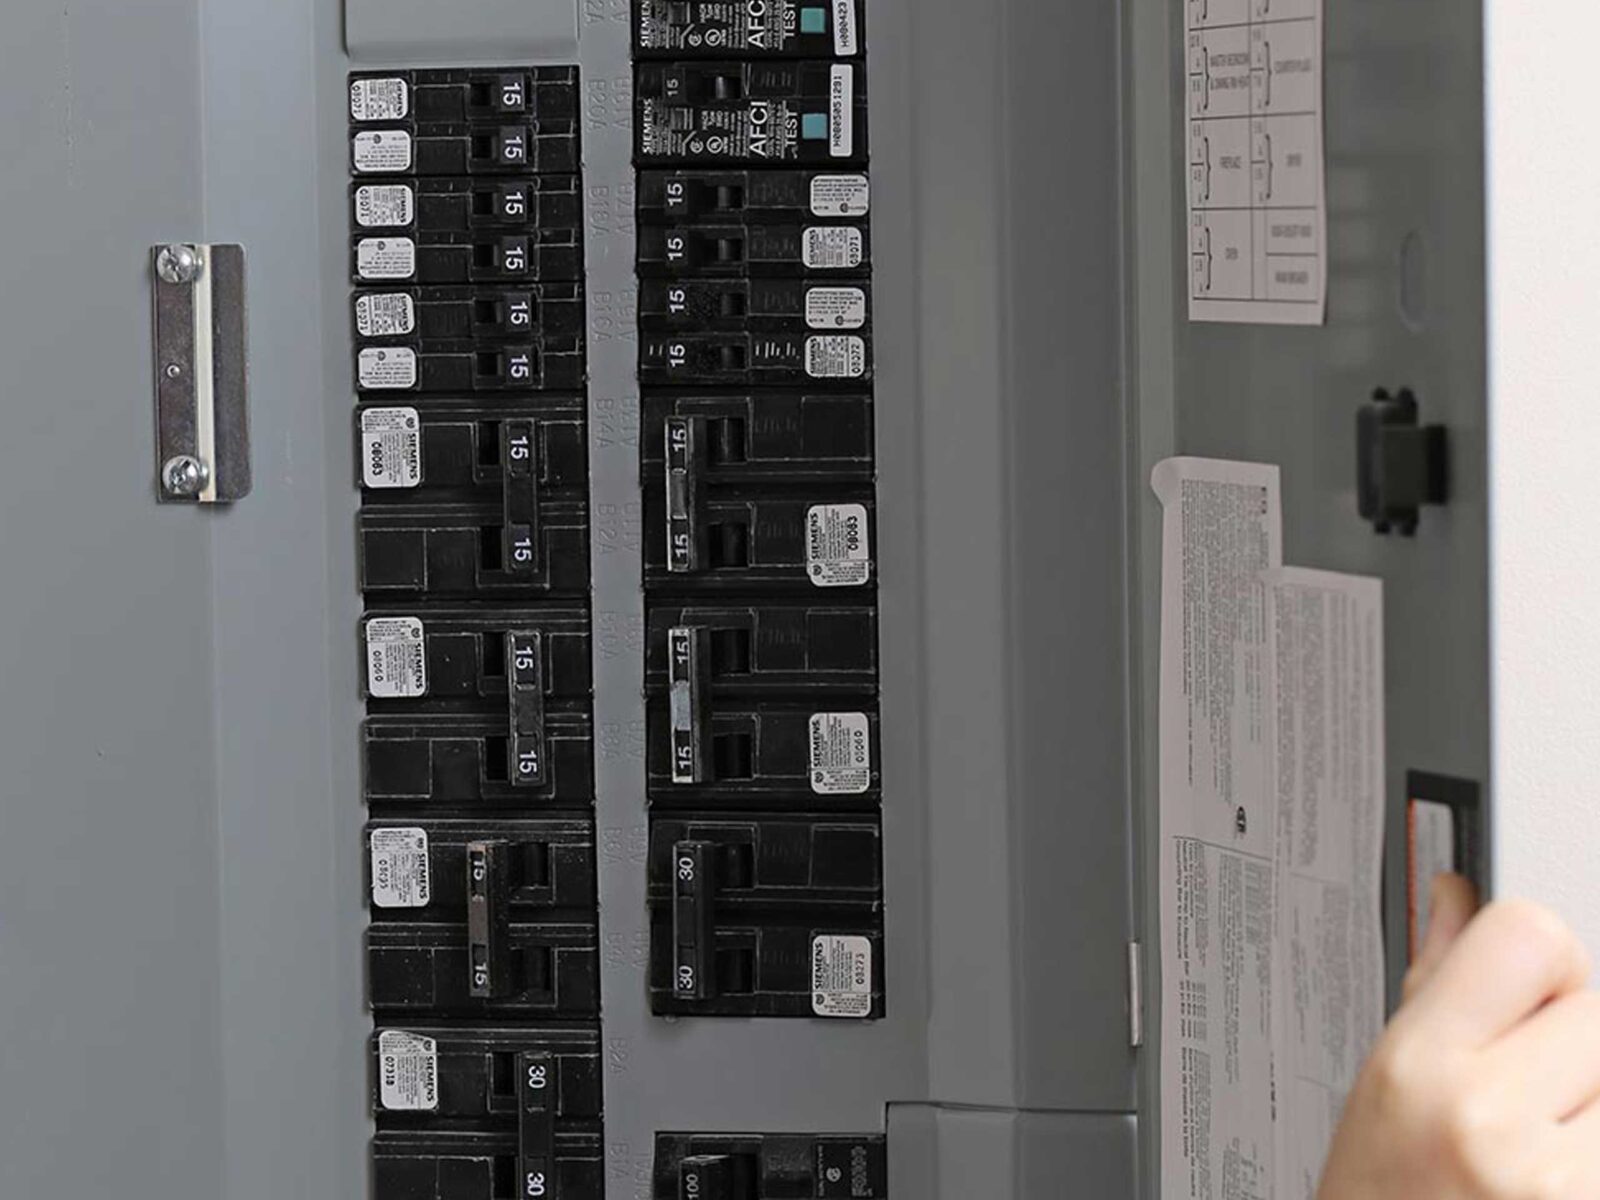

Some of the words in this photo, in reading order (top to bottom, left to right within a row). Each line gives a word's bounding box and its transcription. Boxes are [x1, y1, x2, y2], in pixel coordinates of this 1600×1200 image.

[783, 2, 796, 39] TEST
[503, 83, 521, 105] 15
[667, 78, 679, 96] 15
[642, 98, 652, 153] SIEMENS
[749, 101, 767, 157] AFCI
[785, 110, 798, 147] TEST
[504, 136, 522, 158] 15
[505, 192, 523, 215] 15
[668, 183, 683, 206] 15
[505, 247, 523, 269] 15
[668, 238, 683, 261] 15
[511, 302, 528, 324] 15
[669, 290, 685, 313] 15
[511, 355, 529, 377] 15
[670, 344, 685, 367] 15
[511, 436, 529, 459] 15
[673, 428, 687, 451] 15
[409, 433, 417, 479] SIEMENS
[675, 534, 688, 558] 15
[810, 512, 819, 560] SIEMENS
[514, 538, 532, 561] 15
[516, 647, 533, 670] 15
[677, 641, 690, 664] 15
[414, 642, 423, 689] SIEMENS
[519, 751, 537, 773] 15
[679, 746, 691, 769] 15
[418, 853, 426, 899] SIEMENS
[473, 860, 486, 882] 15
[679, 857, 694, 881] 30
[475, 962, 487, 986] 15
[815, 942, 823, 989] SIEMENS
[680, 966, 693, 989] 30
[426, 1055, 435, 1101] SIEMENS
[528, 1065, 546, 1089] 30
[528, 1173, 545, 1196] 30
[686, 1173, 699, 1200] 100
